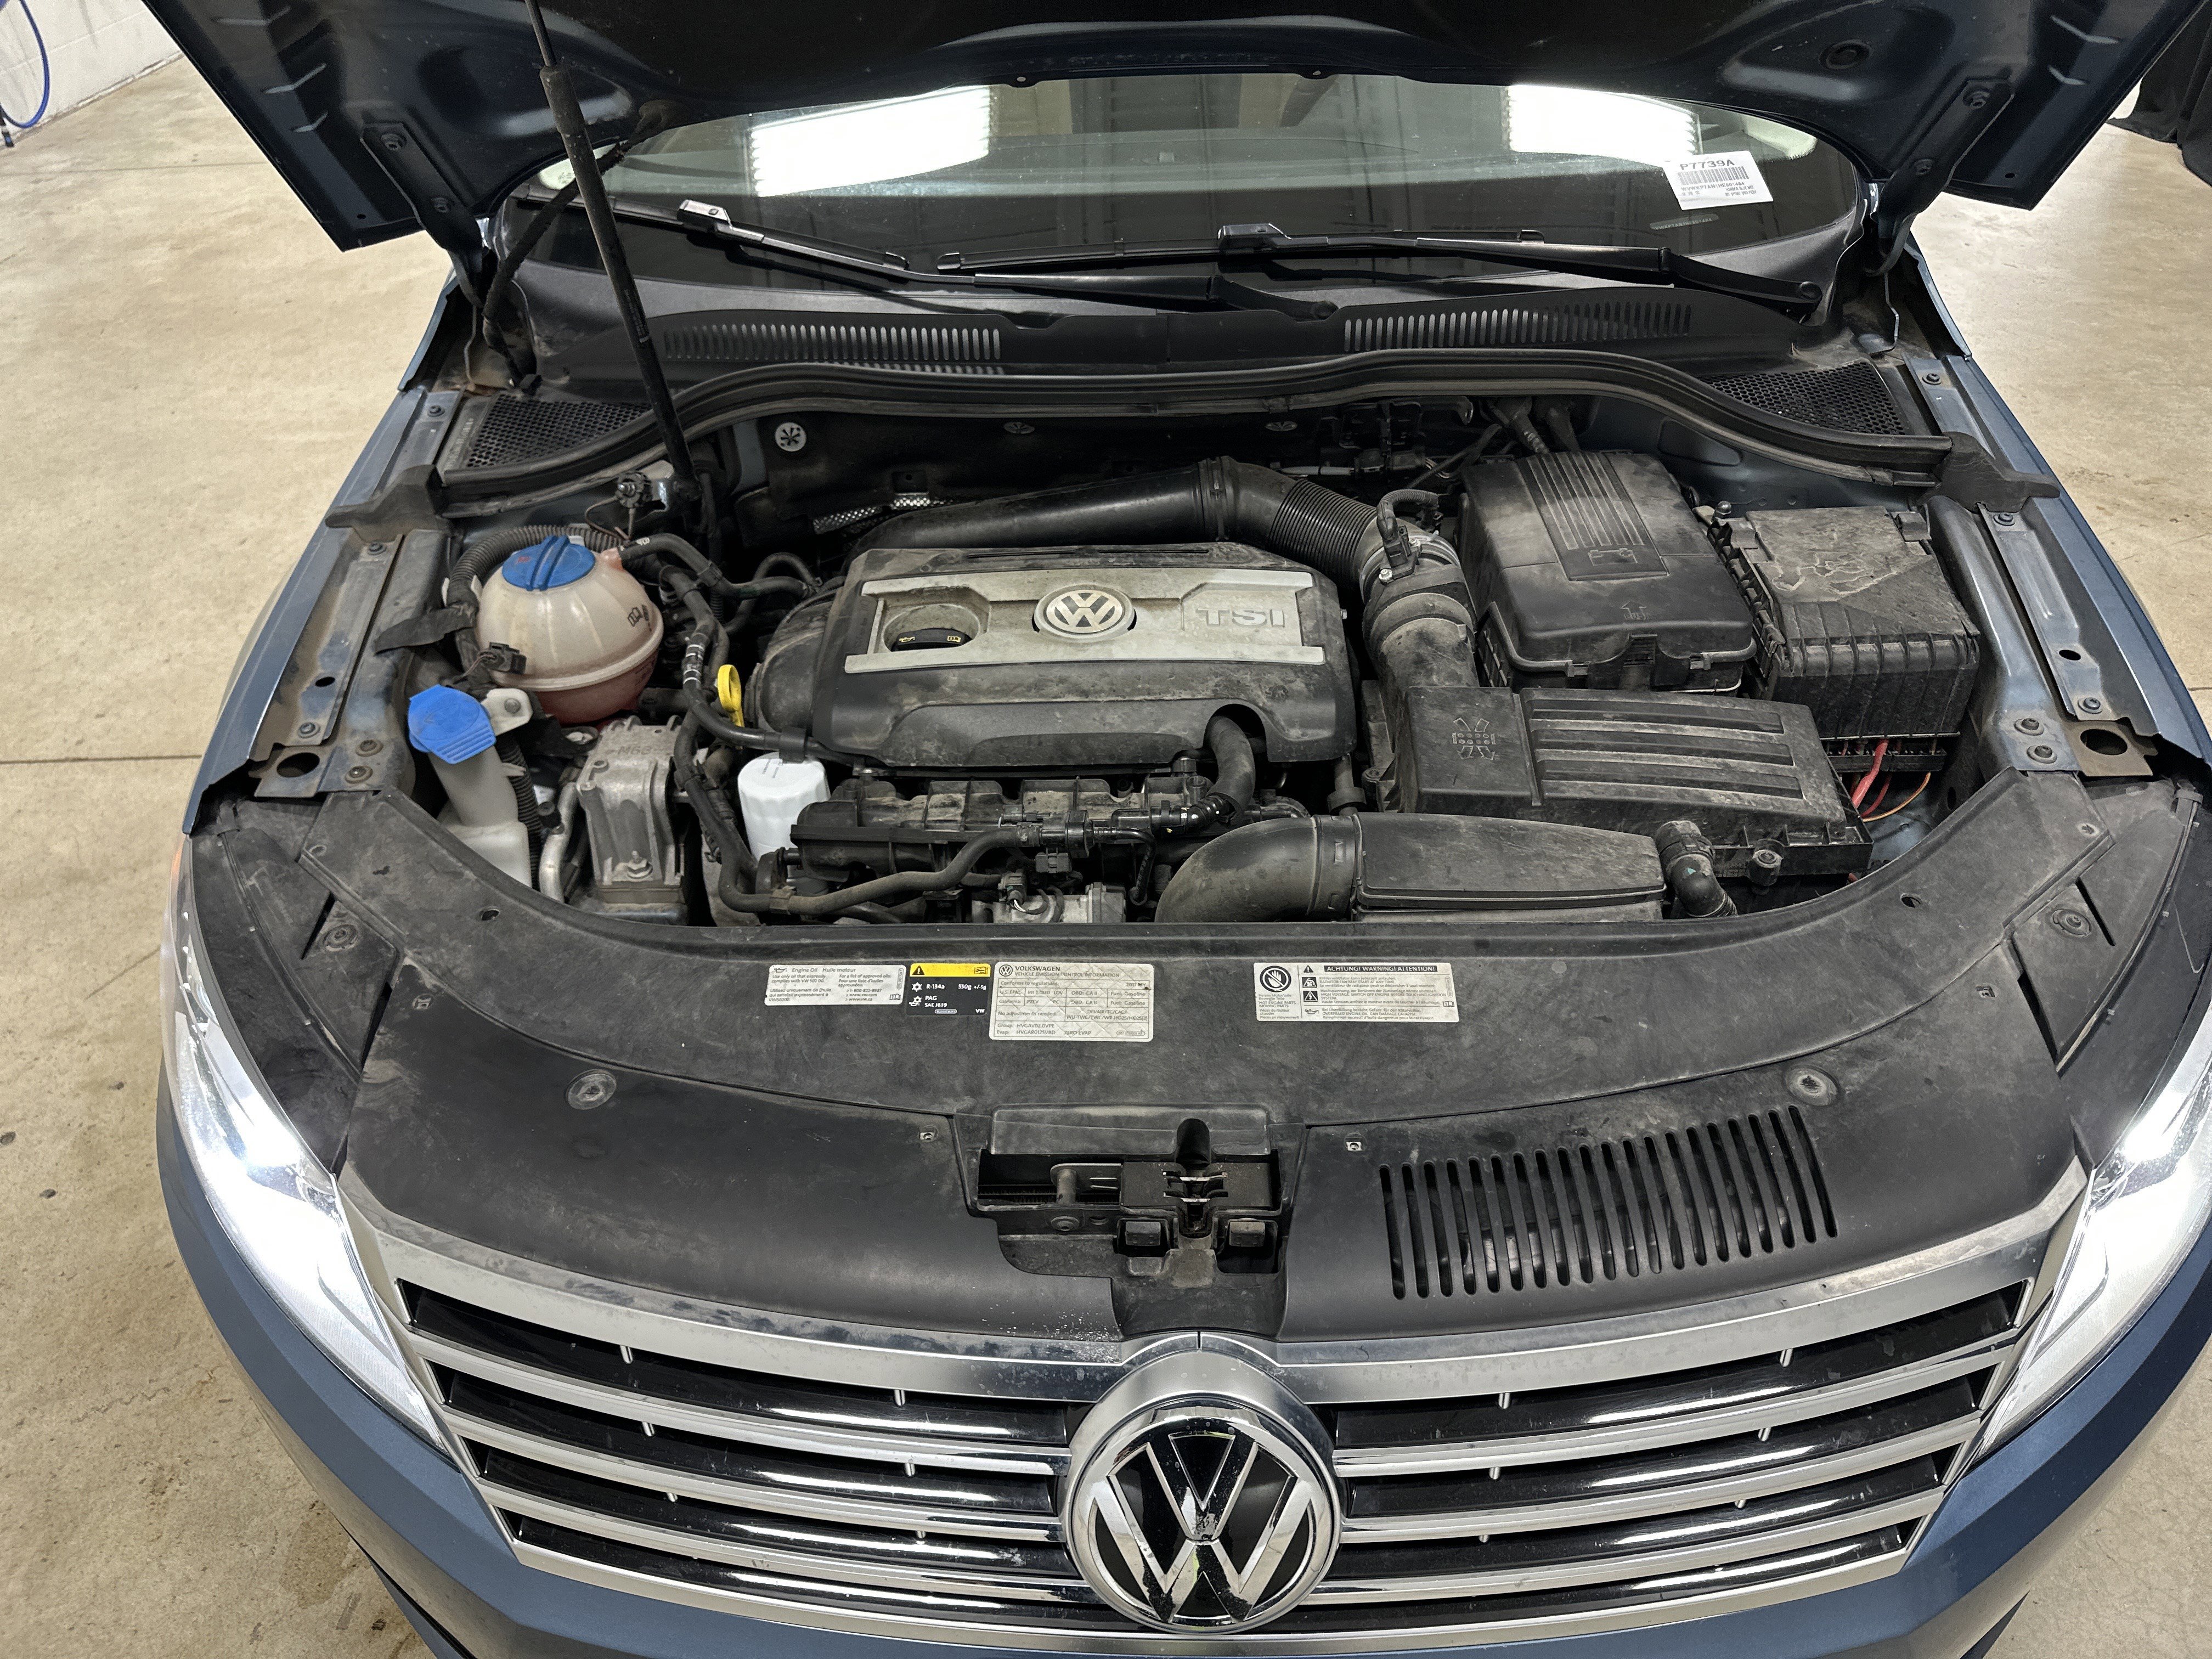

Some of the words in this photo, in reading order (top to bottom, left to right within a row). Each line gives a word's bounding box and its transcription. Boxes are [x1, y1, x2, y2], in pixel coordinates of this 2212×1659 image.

[1680, 159, 1735, 171] P7739A
[1046, 589, 1122, 633] VW
[1197, 609, 1285, 628] TSI
[1076, 1402, 1333, 1632] VW
